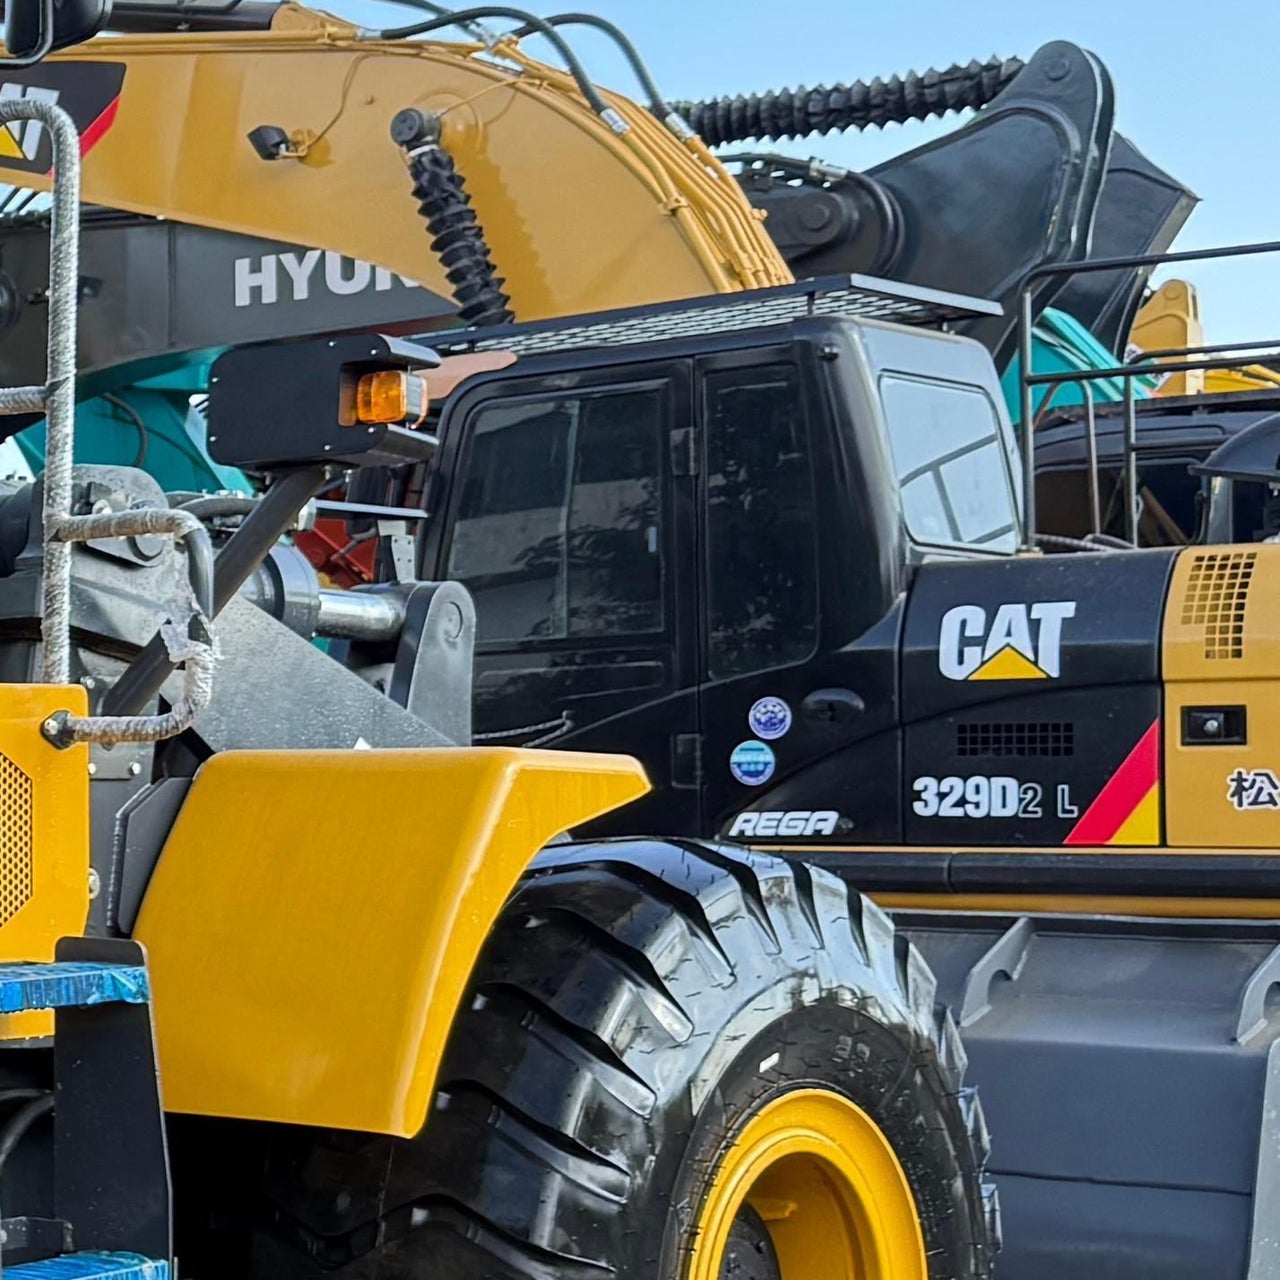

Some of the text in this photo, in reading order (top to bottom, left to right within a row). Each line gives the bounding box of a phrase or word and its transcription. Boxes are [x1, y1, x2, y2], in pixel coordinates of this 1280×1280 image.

[938, 601, 1077, 682] CAT
[1056, 783, 1079, 819] L
[1228, 769, 1280, 809] 松
